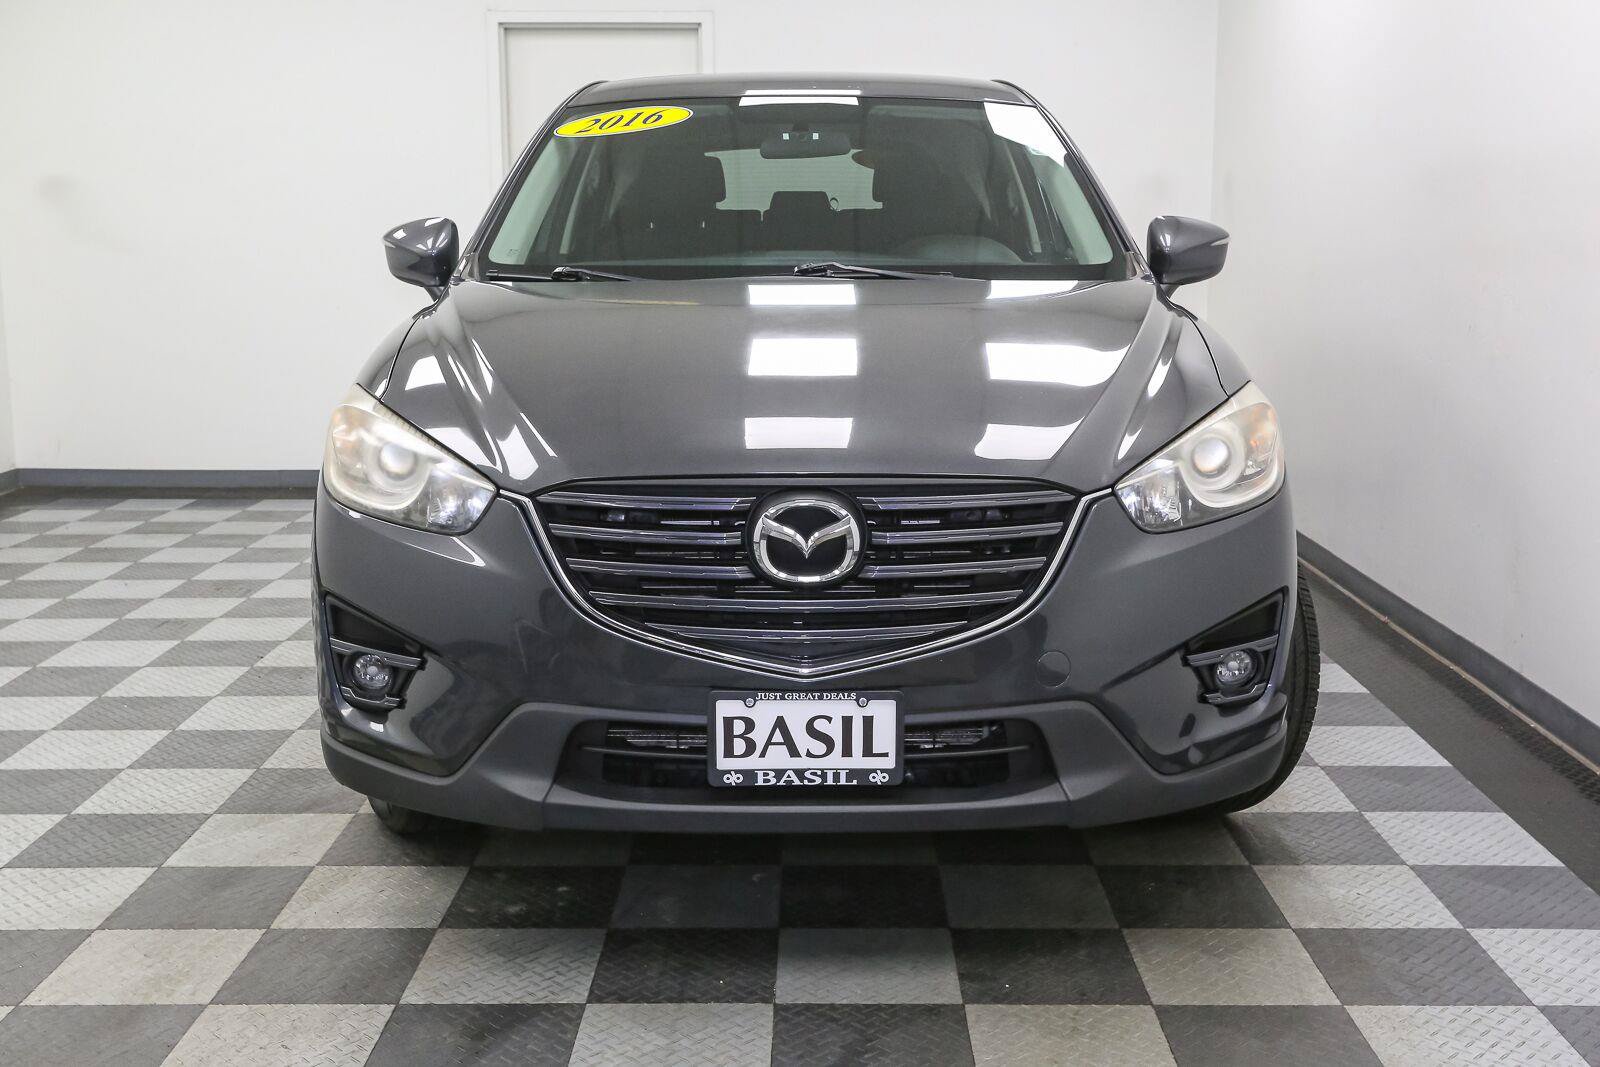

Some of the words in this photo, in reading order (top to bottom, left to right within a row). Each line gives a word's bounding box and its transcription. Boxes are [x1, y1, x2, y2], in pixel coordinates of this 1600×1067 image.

[575, 109, 670, 134] 2016
[755, 692, 782, 700] JUST
[784, 692, 820, 700] GREAT
[823, 692, 857, 700] DEALS
[722, 714, 890, 759] BASIL
[754, 769, 858, 786] BASIL
